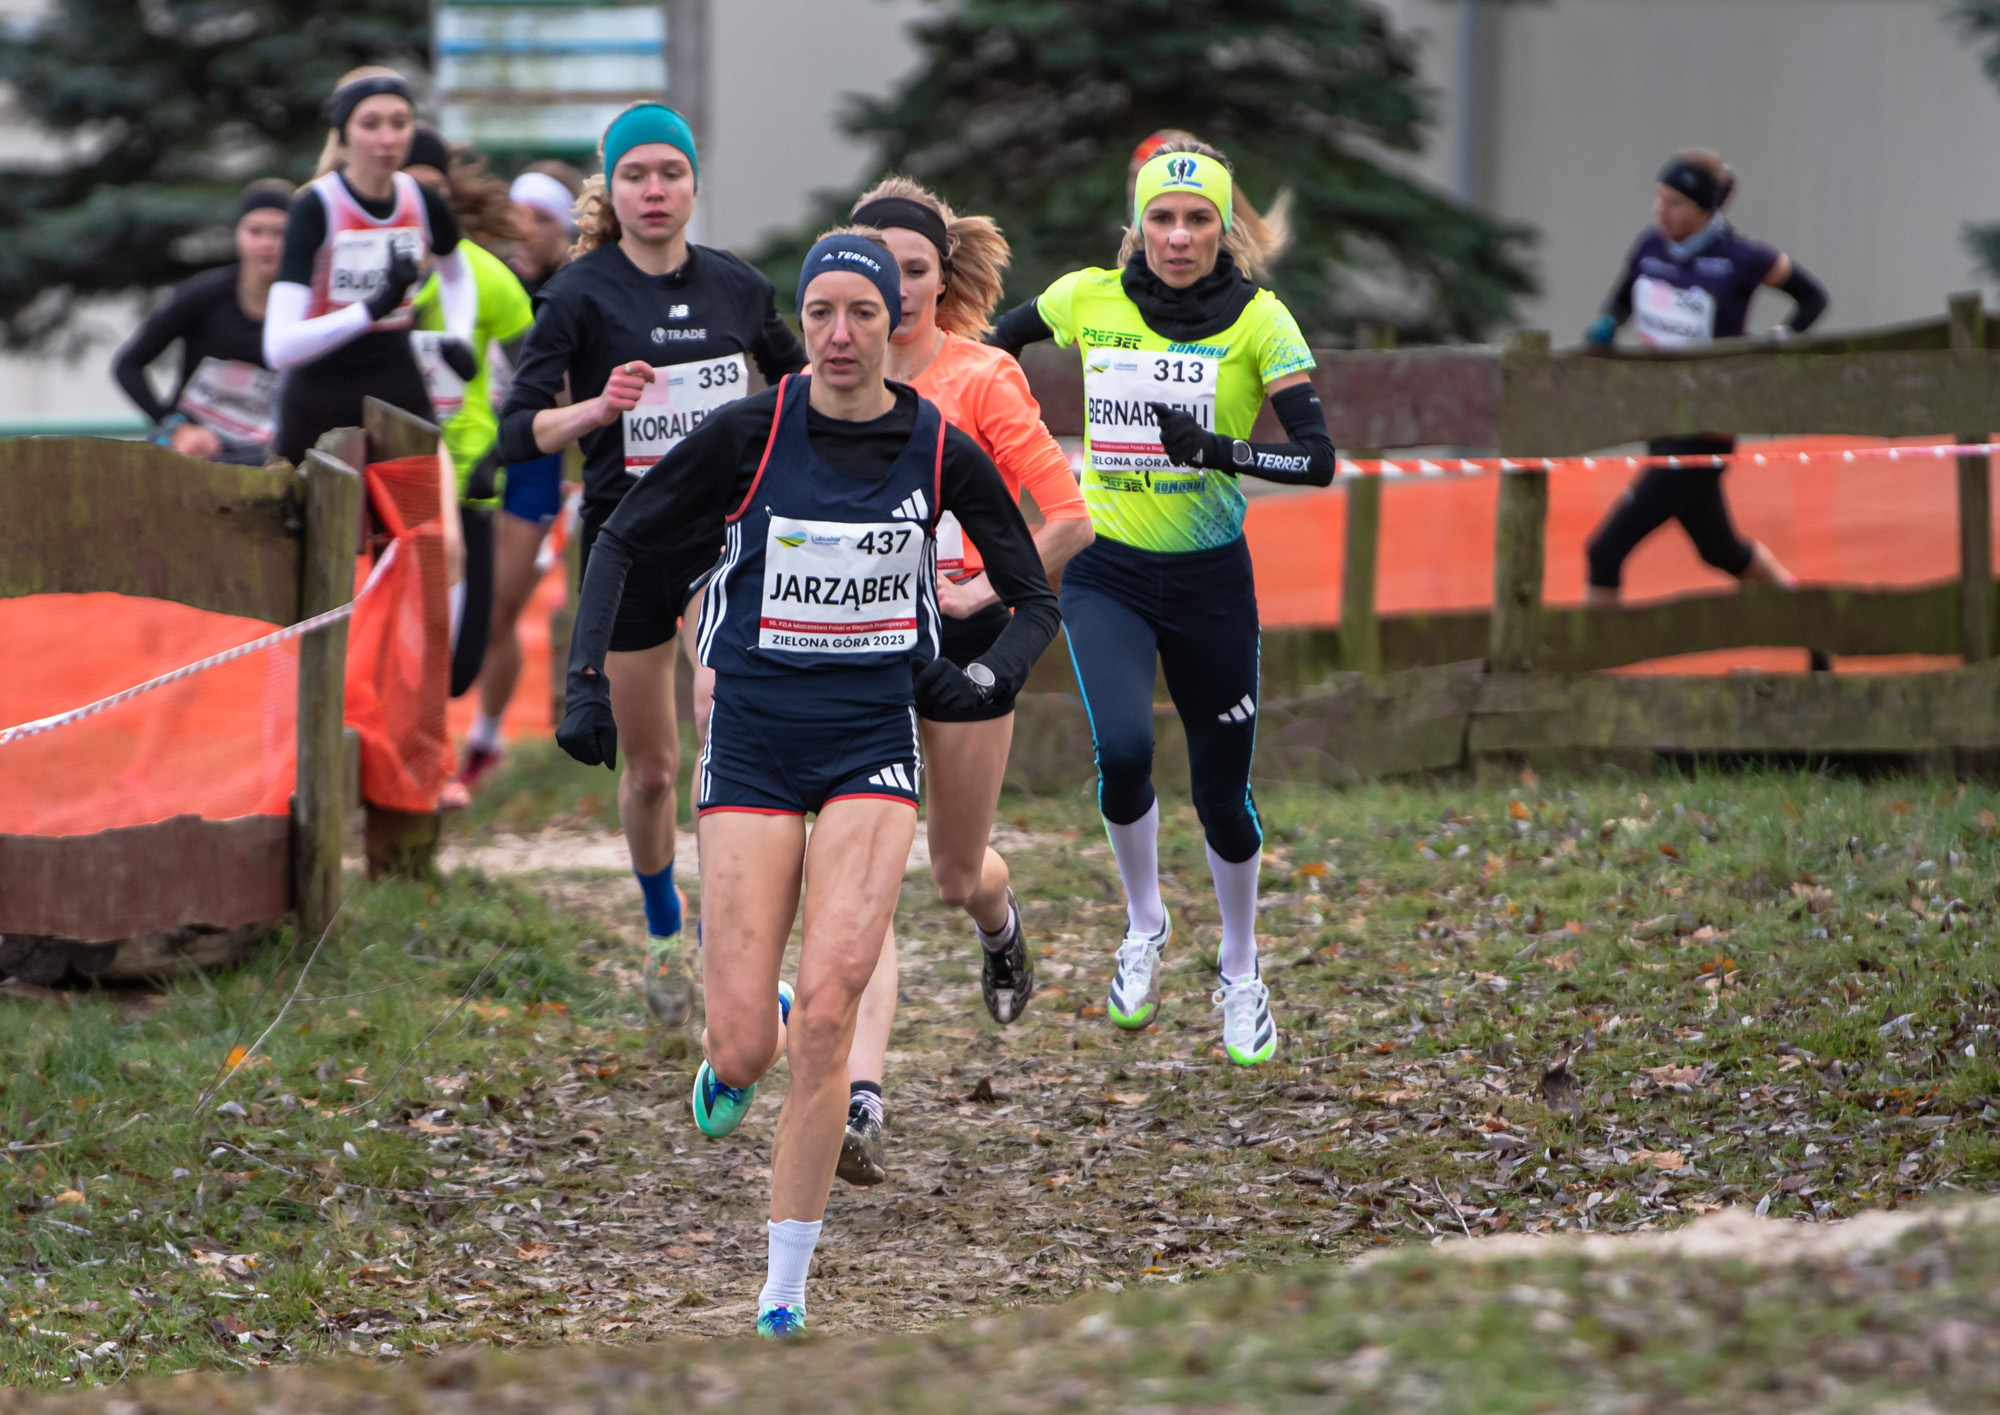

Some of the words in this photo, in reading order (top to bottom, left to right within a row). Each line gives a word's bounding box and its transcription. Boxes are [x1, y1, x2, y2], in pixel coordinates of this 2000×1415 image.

[837, 251, 881, 273] TERREX
[667, 328, 707, 341] TRADE
[1083, 327, 1142, 350] PREFBET
[698, 361, 740, 389] 333
[1153, 358, 1204, 383] 313
[1134, 455, 1170, 468] GÓRA
[1256, 452, 1311, 472] TERREX
[857, 529, 912, 555] 437
[769, 572, 911, 611] JARZĄBEK
[772, 634, 829, 648] ZIELONA
[832, 635, 870, 648] GÓRA
[873, 635, 905, 646] 2023
